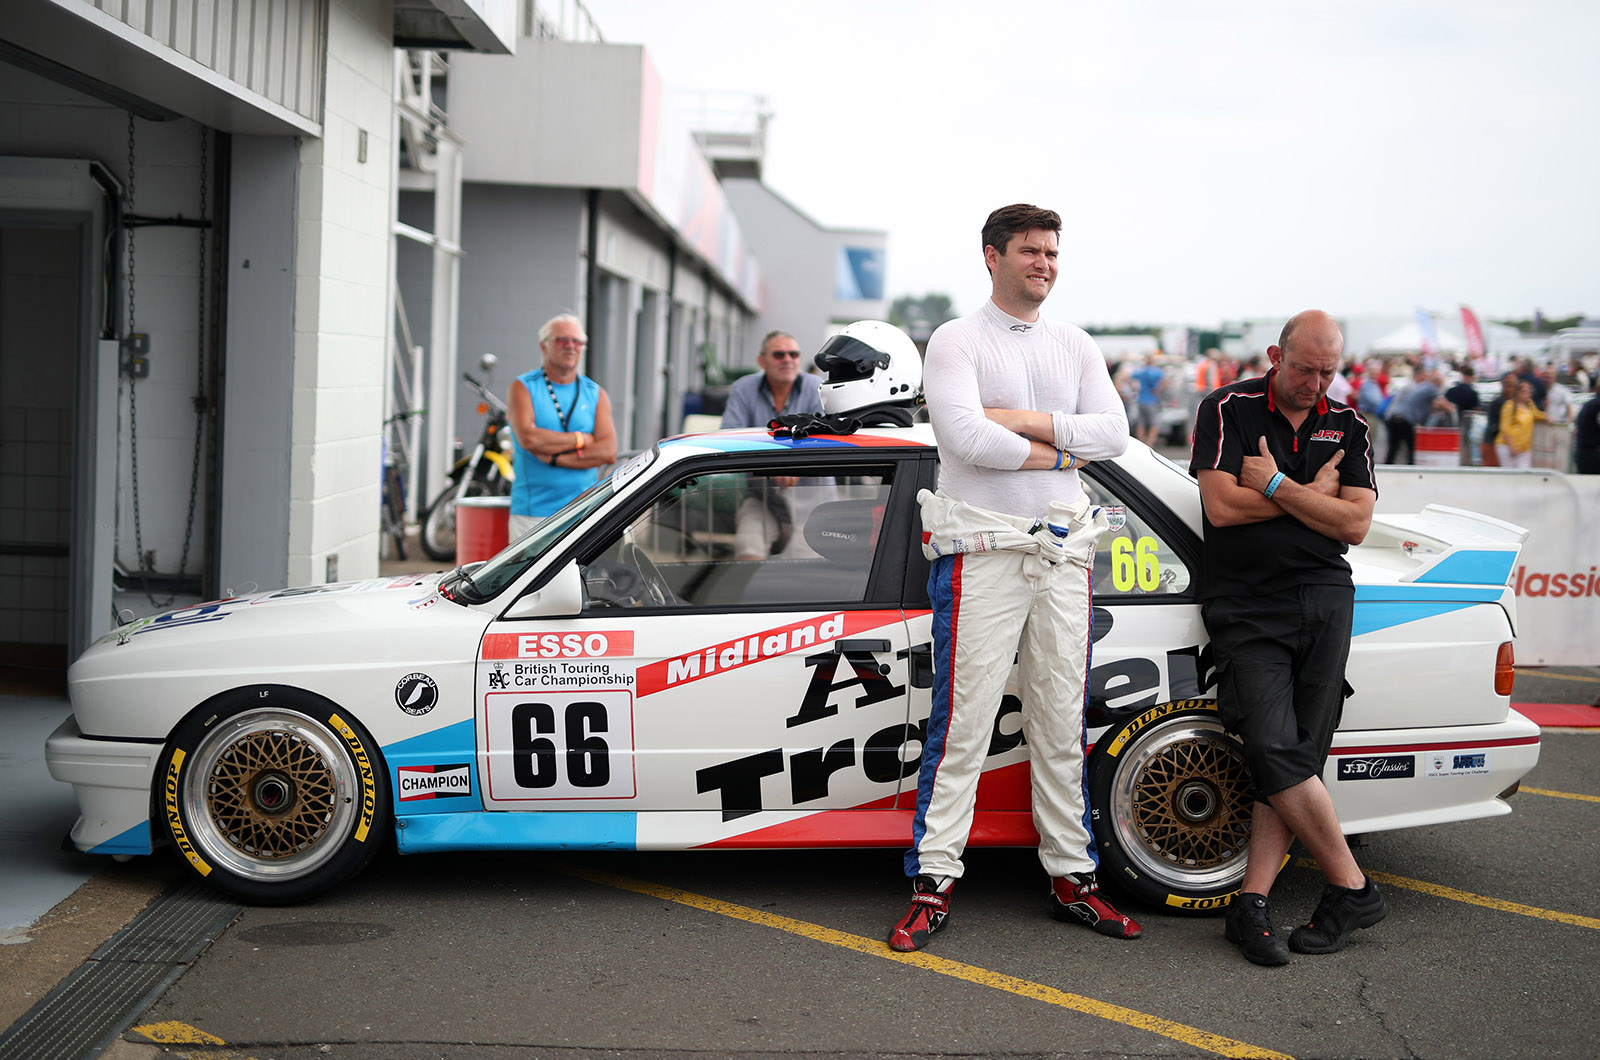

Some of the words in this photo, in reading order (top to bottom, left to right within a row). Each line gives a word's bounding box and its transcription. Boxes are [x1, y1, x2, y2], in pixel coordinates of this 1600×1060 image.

[1311, 430, 1344, 439] JRT
[1111, 536, 1160, 592] 66
[1511, 566, 1600, 598] lassi
[518, 634, 608, 658] ESSO
[667, 614, 845, 685] Midland
[514, 663, 556, 675] British
[560, 663, 610, 675] Touring
[397, 673, 436, 690] CORBEAU
[514, 675, 537, 686] Car
[540, 674, 634, 687] Championship
[259, 690, 269, 698] LF
[405, 705, 431, 716] SEATS
[1128, 699, 1216, 738] DUNLOP
[512, 702, 610, 788] 66
[1368, 759, 1409, 778] Classics
[347, 737, 375, 828] DUNLOP
[402, 775, 468, 790] CHAMPION
[166, 764, 194, 857] DUNLOP
